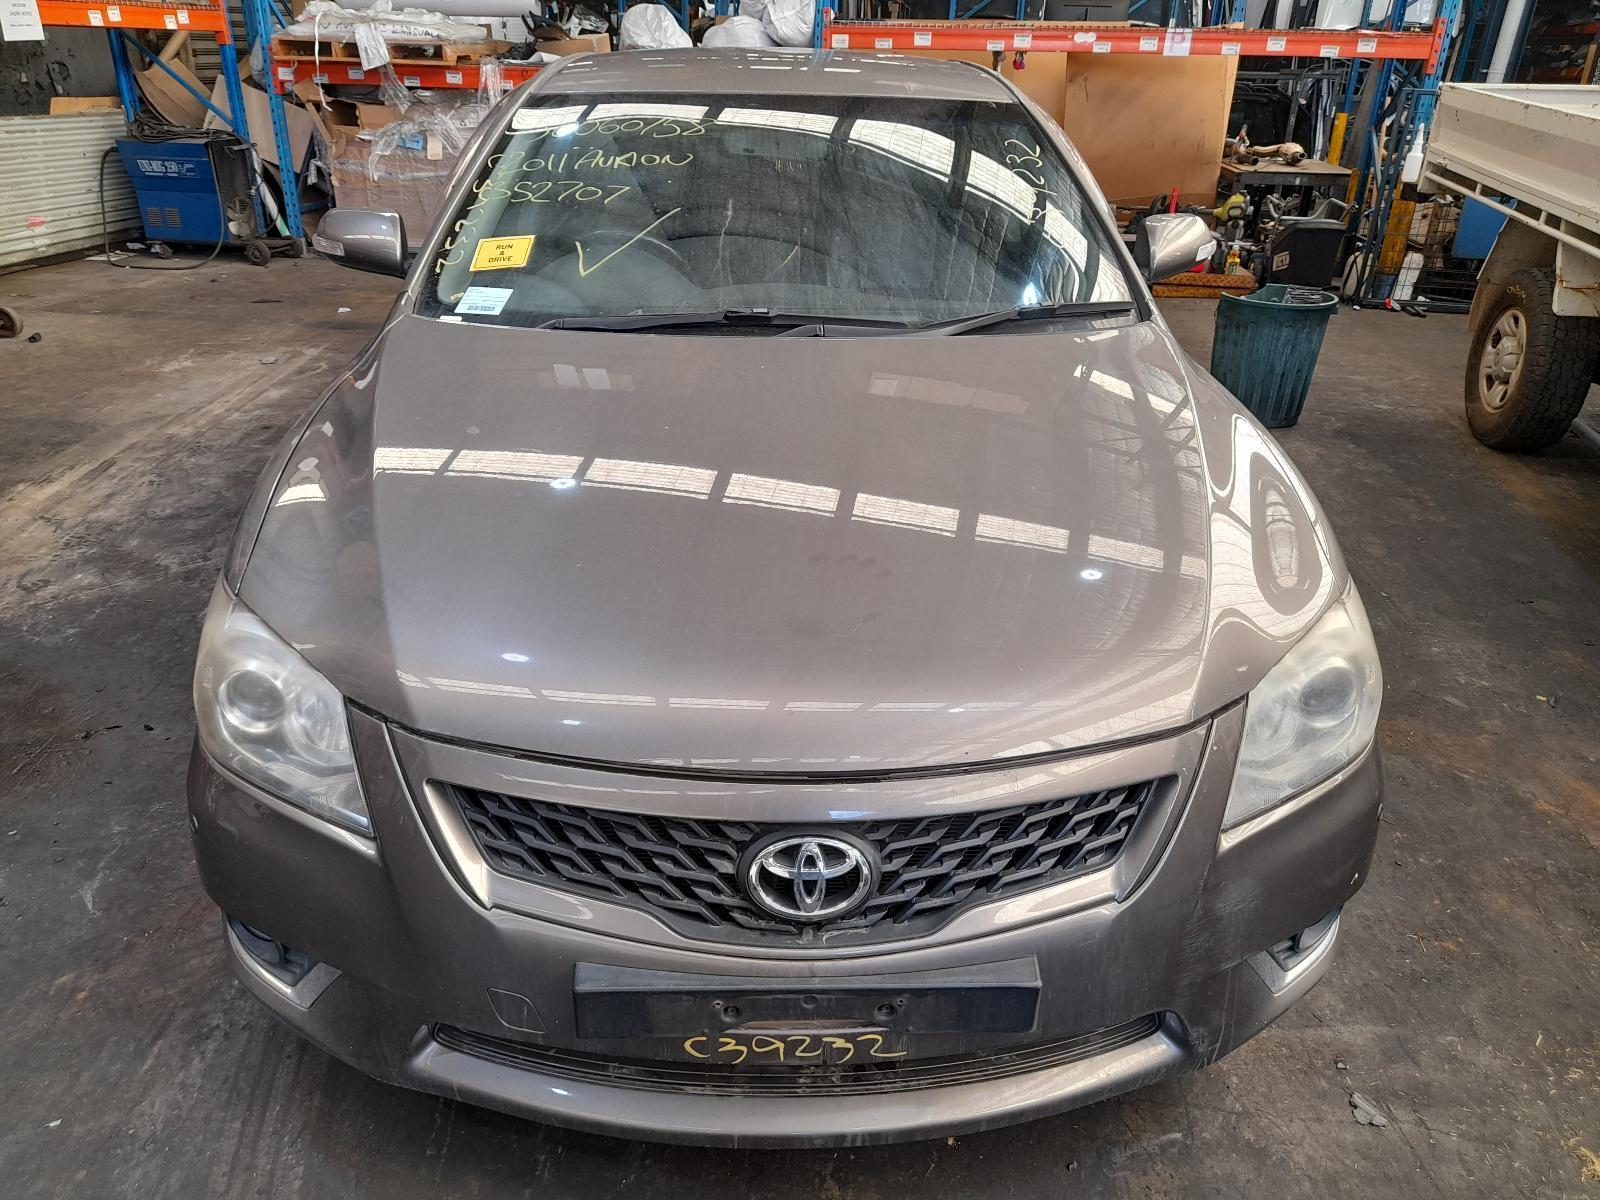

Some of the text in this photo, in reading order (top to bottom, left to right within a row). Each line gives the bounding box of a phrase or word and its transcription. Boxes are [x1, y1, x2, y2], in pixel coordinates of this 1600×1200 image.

[498, 151, 568, 173] 2011
[488, 255, 514, 263] DRIVE
[683, 1034, 908, 1065] C39232
